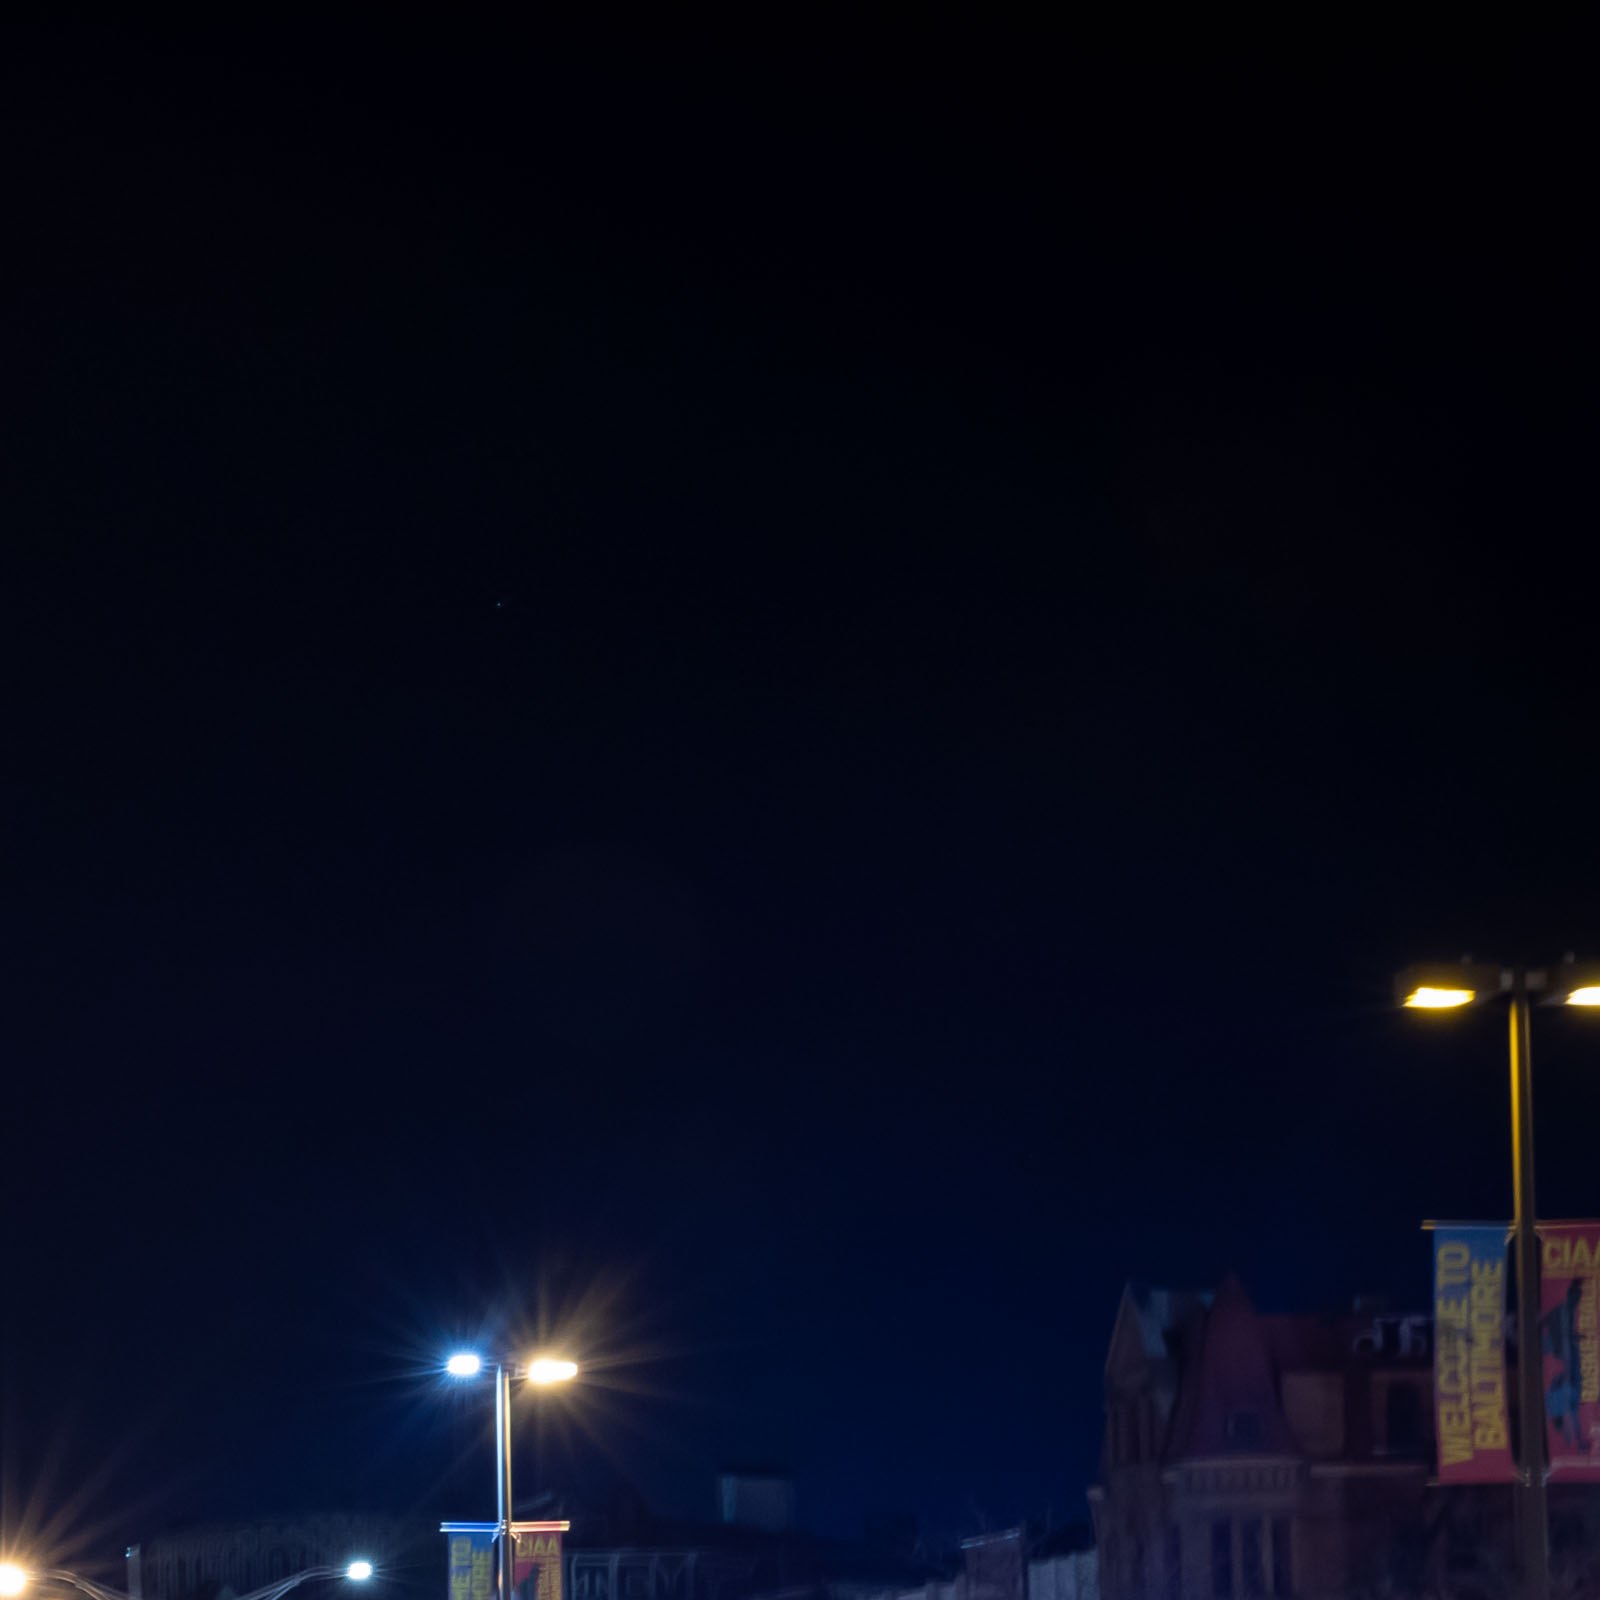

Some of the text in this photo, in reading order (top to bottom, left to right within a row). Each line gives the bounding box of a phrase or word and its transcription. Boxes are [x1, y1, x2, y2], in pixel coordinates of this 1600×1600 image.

[1437, 1243, 1471, 1290] TO
[1542, 1236, 1600, 1268] CIA
[1470, 1260, 1506, 1450] BALTIMORE
[452, 1539, 471, 1568] TO
[516, 1535, 559, 1557] CIAA
